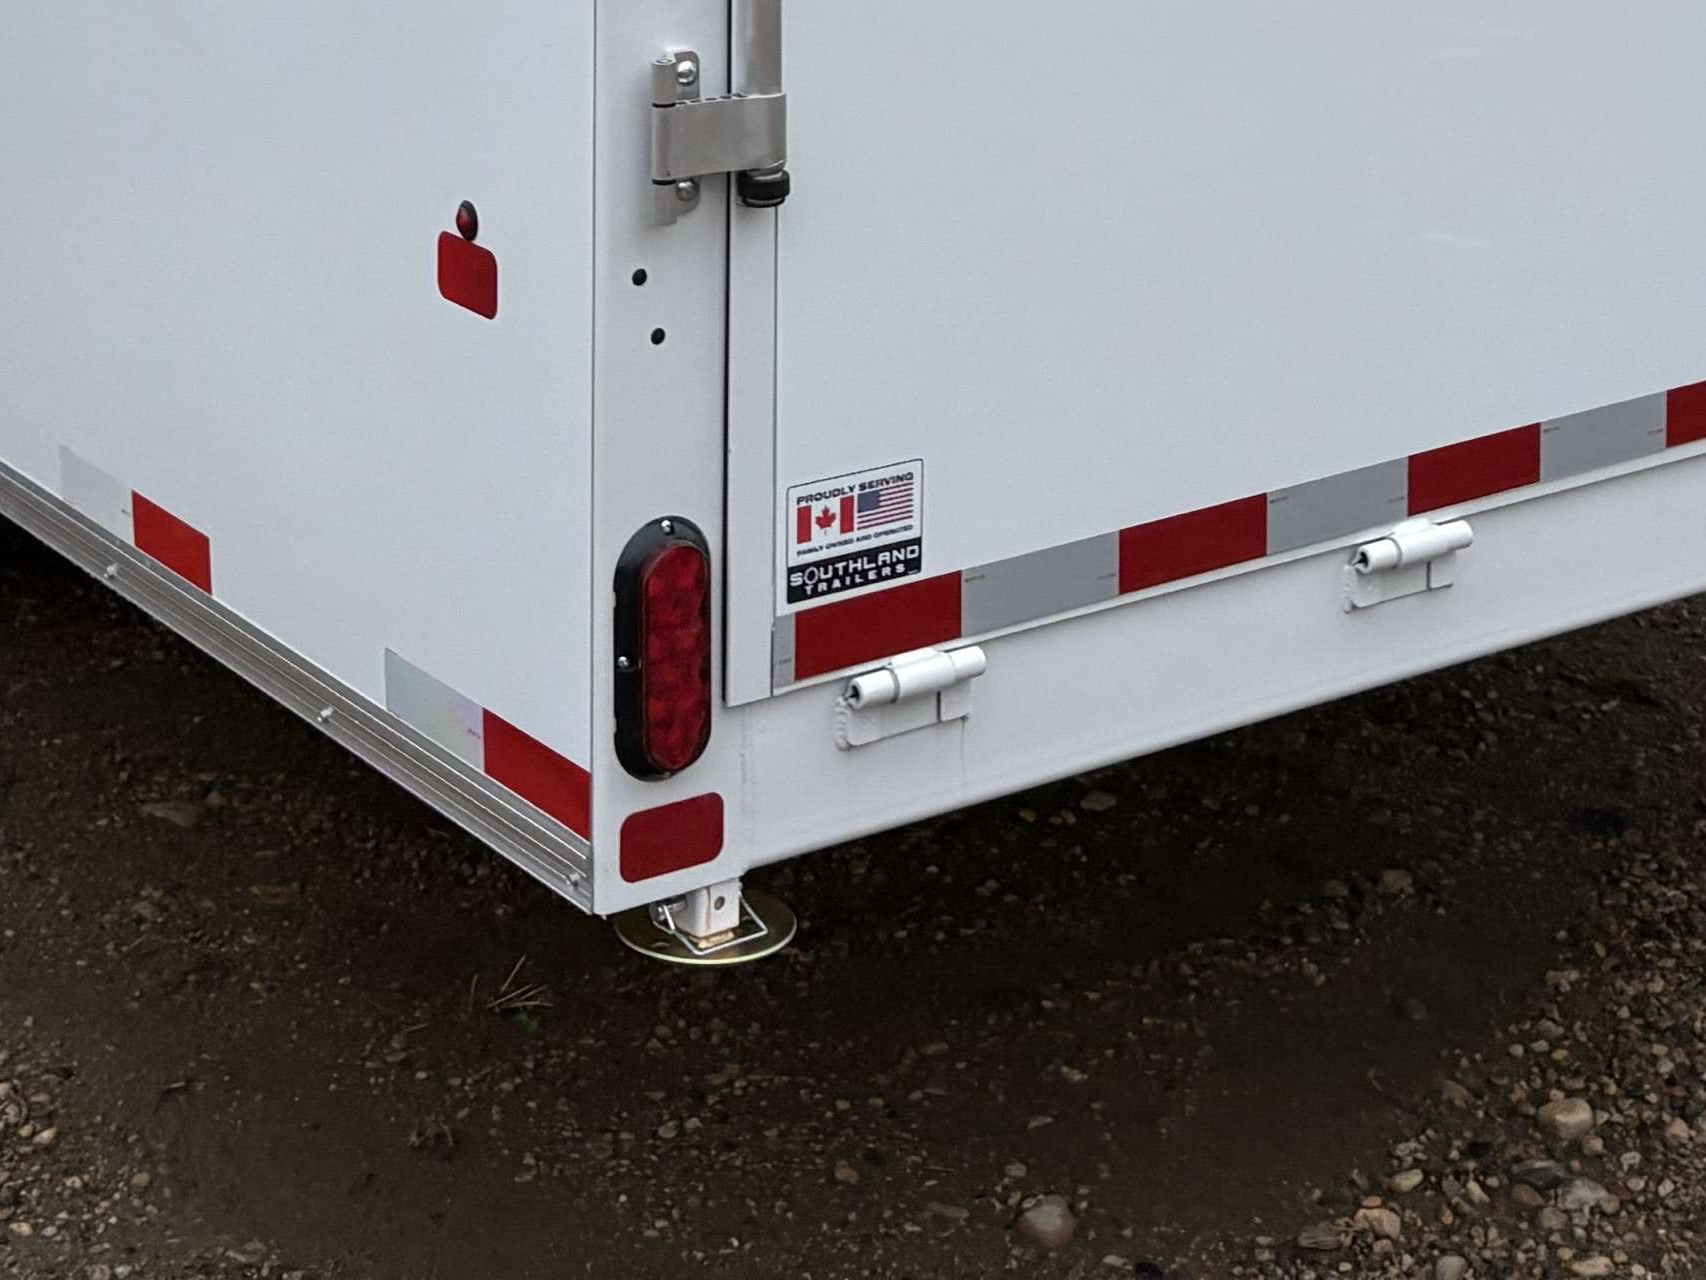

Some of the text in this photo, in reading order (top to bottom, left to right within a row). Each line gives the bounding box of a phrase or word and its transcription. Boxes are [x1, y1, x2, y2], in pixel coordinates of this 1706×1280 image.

[796, 471, 914, 506] PROUDLY SERVING
[789, 544, 919, 586] SOUTHLAND
[804, 563, 906, 596] TRAILERS
